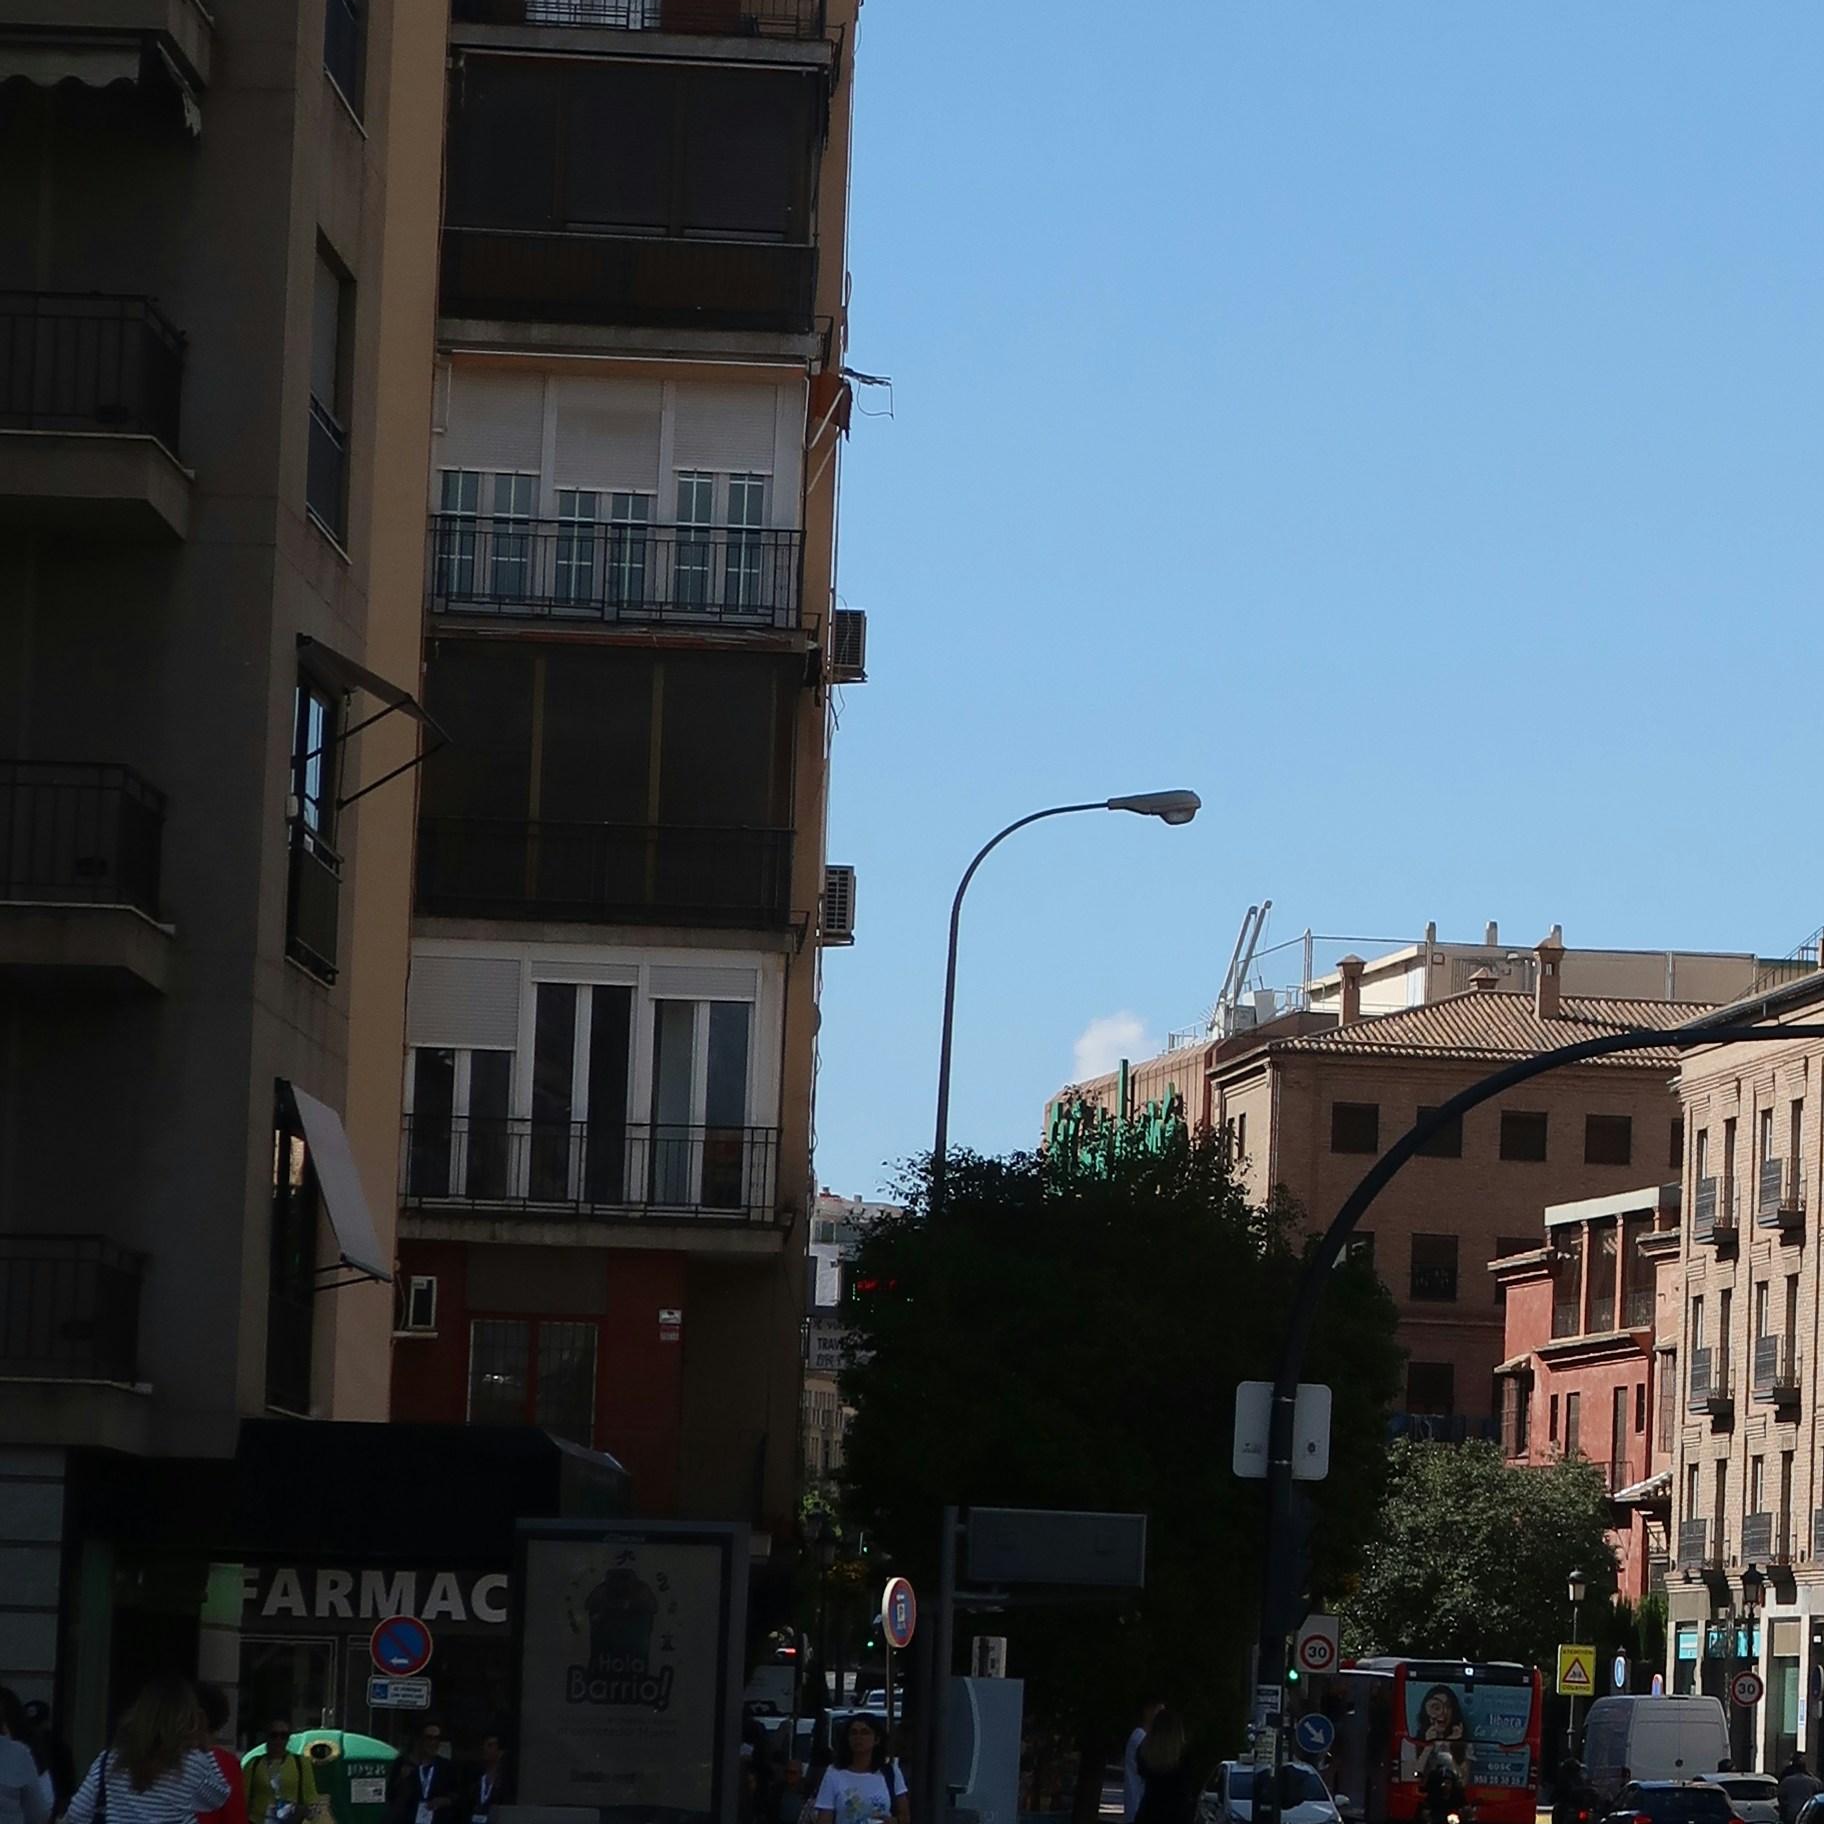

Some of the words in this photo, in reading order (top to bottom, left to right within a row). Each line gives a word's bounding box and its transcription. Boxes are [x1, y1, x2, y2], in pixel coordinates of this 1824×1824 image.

[1308, 1646, 1327, 1658] 30
[570, 1669, 670, 1709] Barrio!
[1738, 1683, 1756, 1695] 30
[1489, 1713, 1522, 1728] libera
